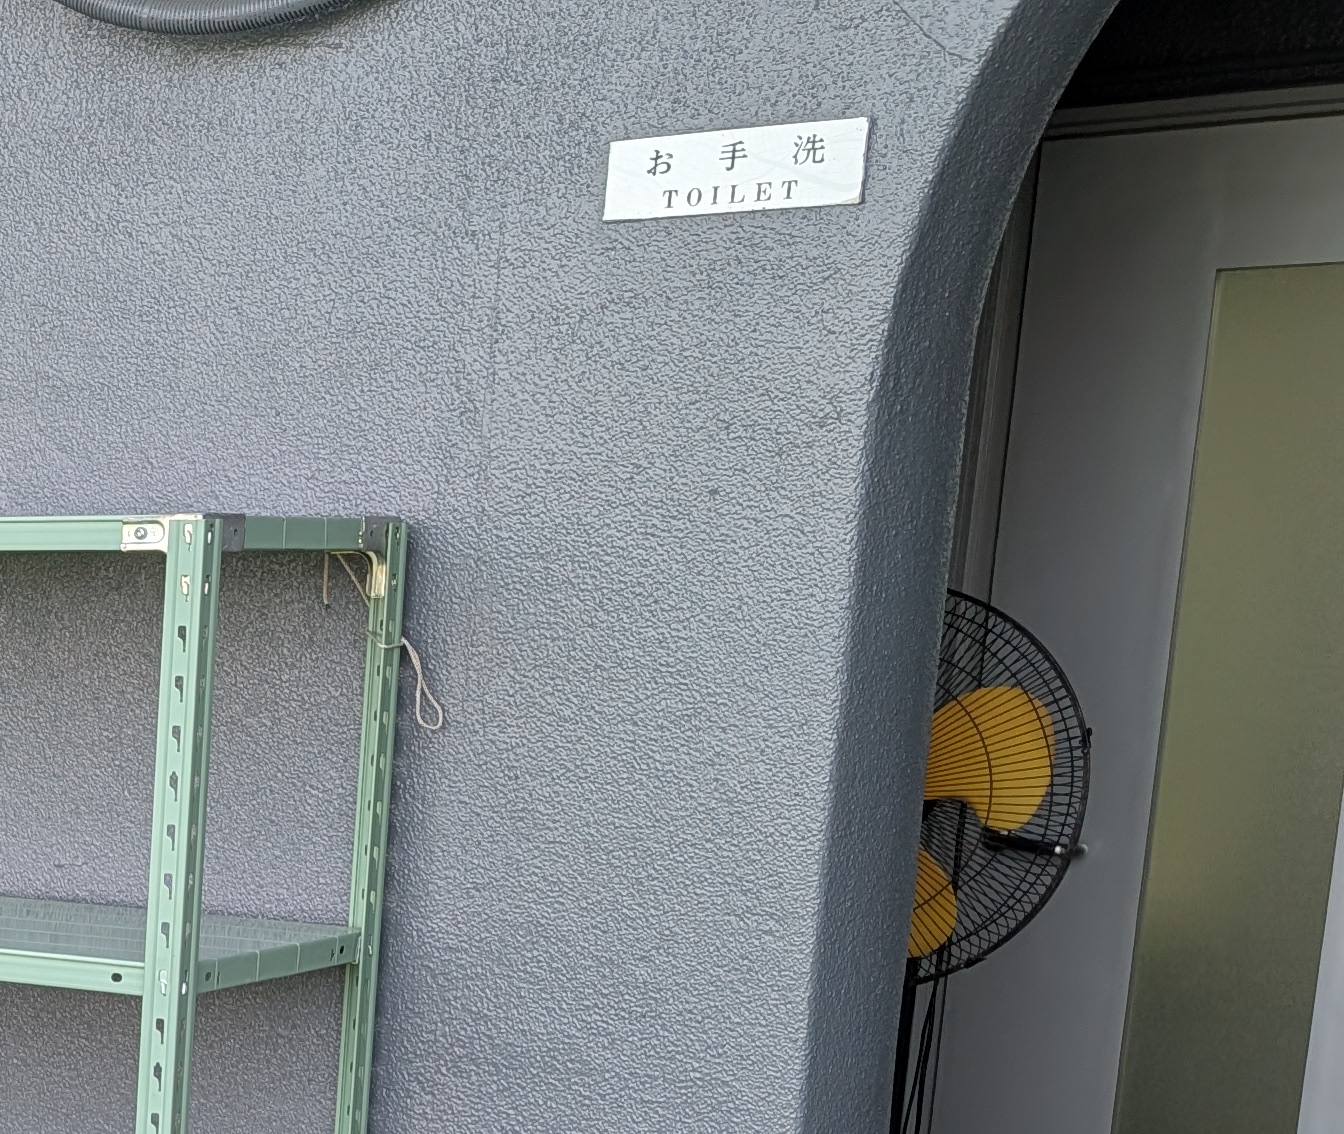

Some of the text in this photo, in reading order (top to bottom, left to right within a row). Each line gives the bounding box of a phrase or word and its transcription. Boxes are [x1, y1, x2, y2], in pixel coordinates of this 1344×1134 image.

[646, 135, 826, 177] お手洗
[662, 179, 799, 209] TOILET
